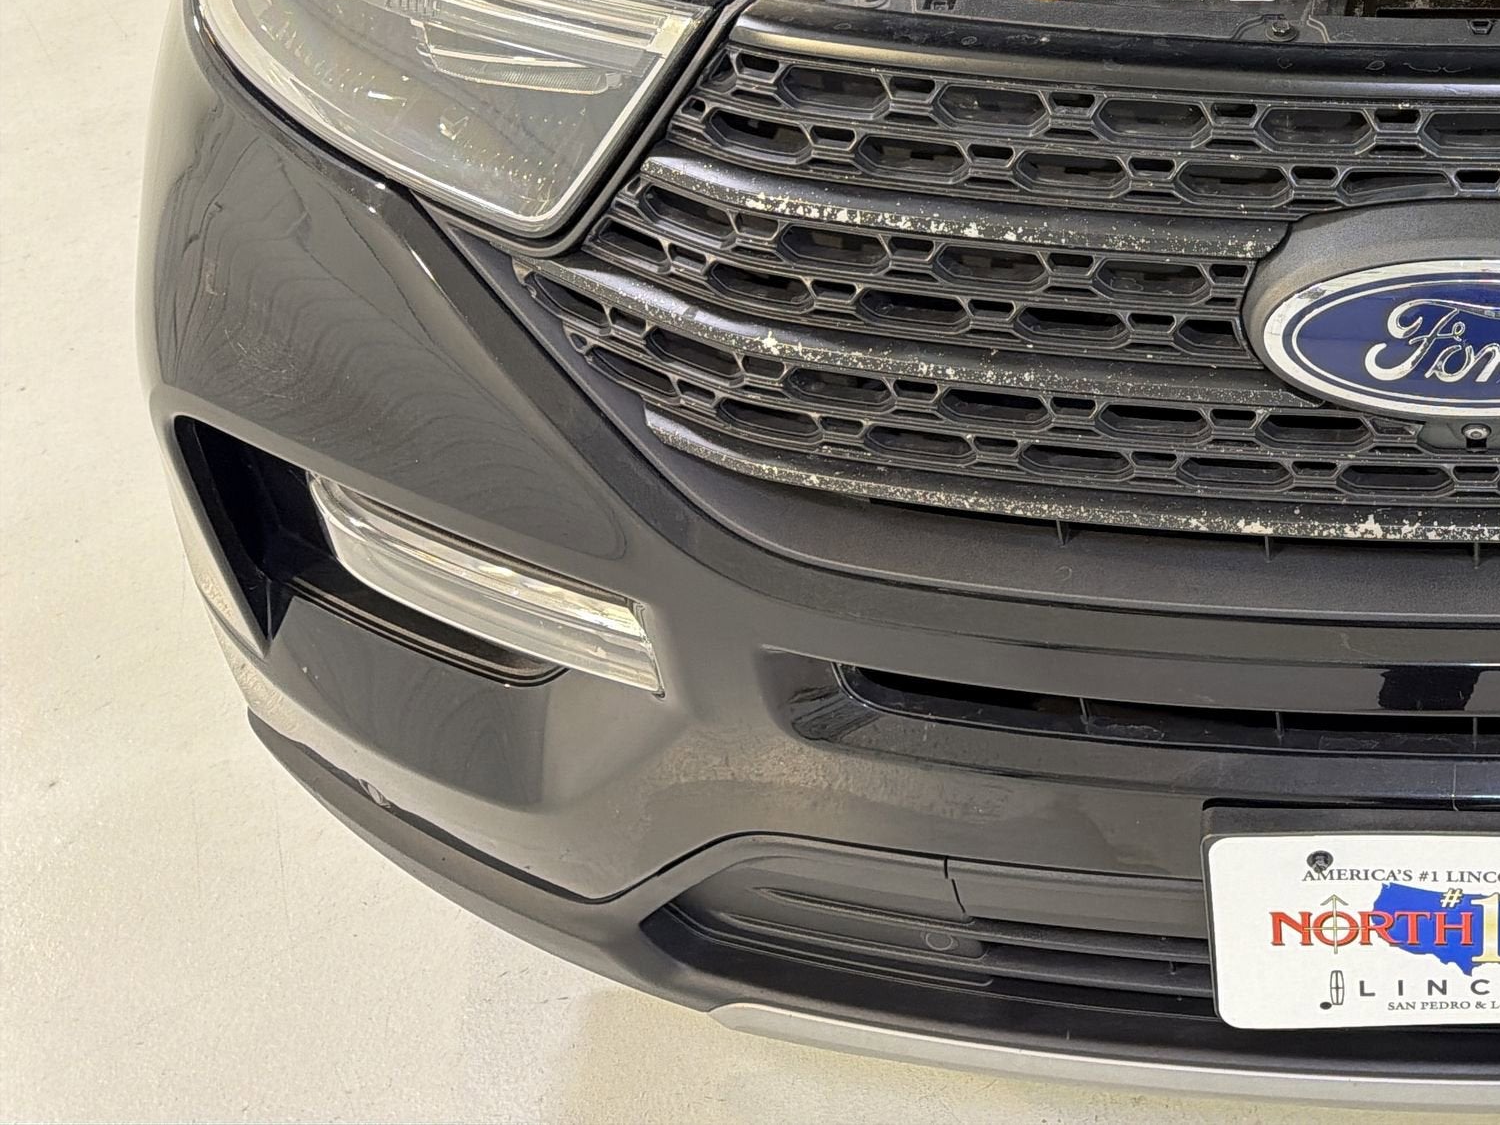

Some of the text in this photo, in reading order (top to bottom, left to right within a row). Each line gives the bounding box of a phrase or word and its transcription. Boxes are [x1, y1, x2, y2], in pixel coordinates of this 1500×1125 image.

[1302, 868, 1413, 882] AMERICA'S
[1419, 871, 1438, 883] #1
[1270, 911, 1475, 947] NORTH
[1387, 1001, 1417, 1011] SAN
[1420, 1001, 1472, 1010] PEDRO
[1474, 1001, 1487, 1010] &
